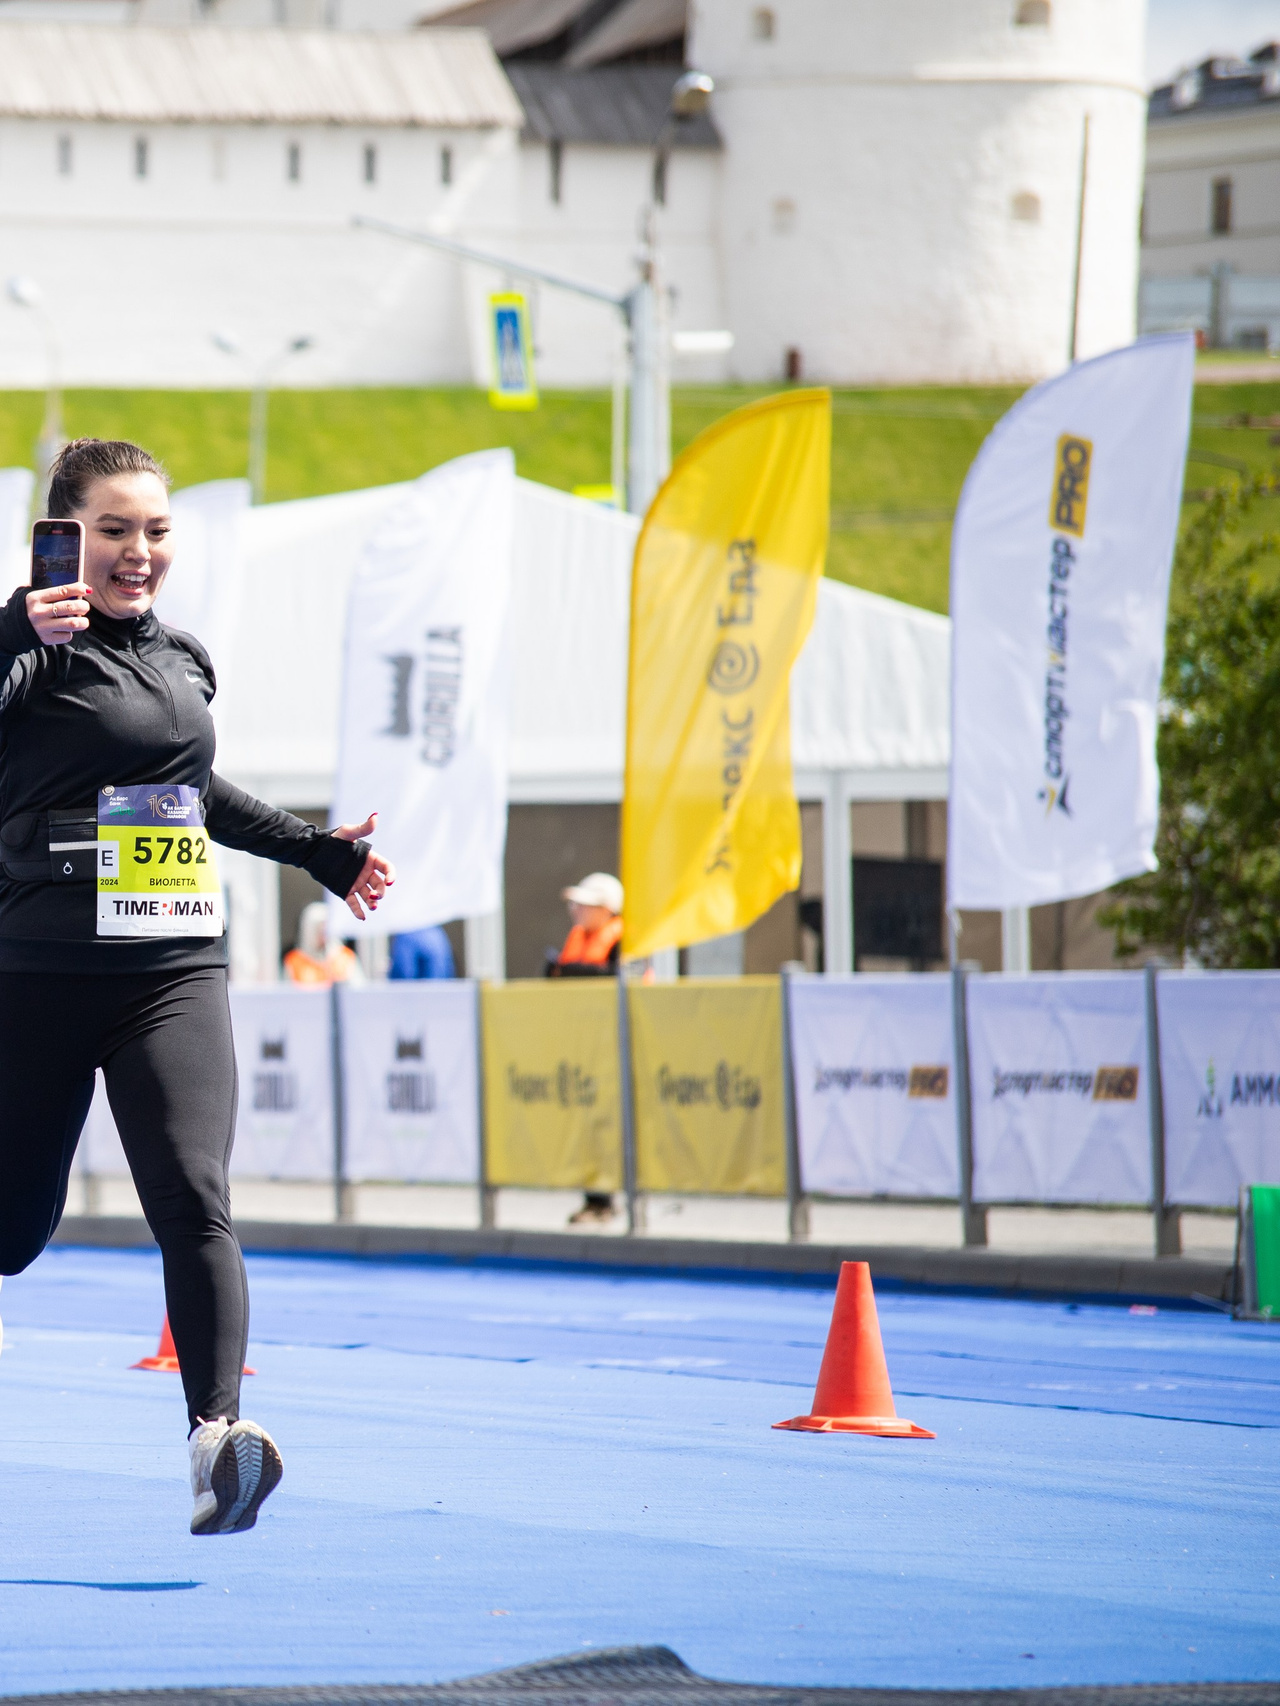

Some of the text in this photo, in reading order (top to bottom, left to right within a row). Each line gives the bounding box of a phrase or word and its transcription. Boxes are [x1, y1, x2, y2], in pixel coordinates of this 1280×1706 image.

[1054, 440, 1087, 531] PRO
[132, 836, 207, 865] 5782
[100, 878, 119, 886] 2024
[149, 878, 197, 887] ВИОЛЕТТА
